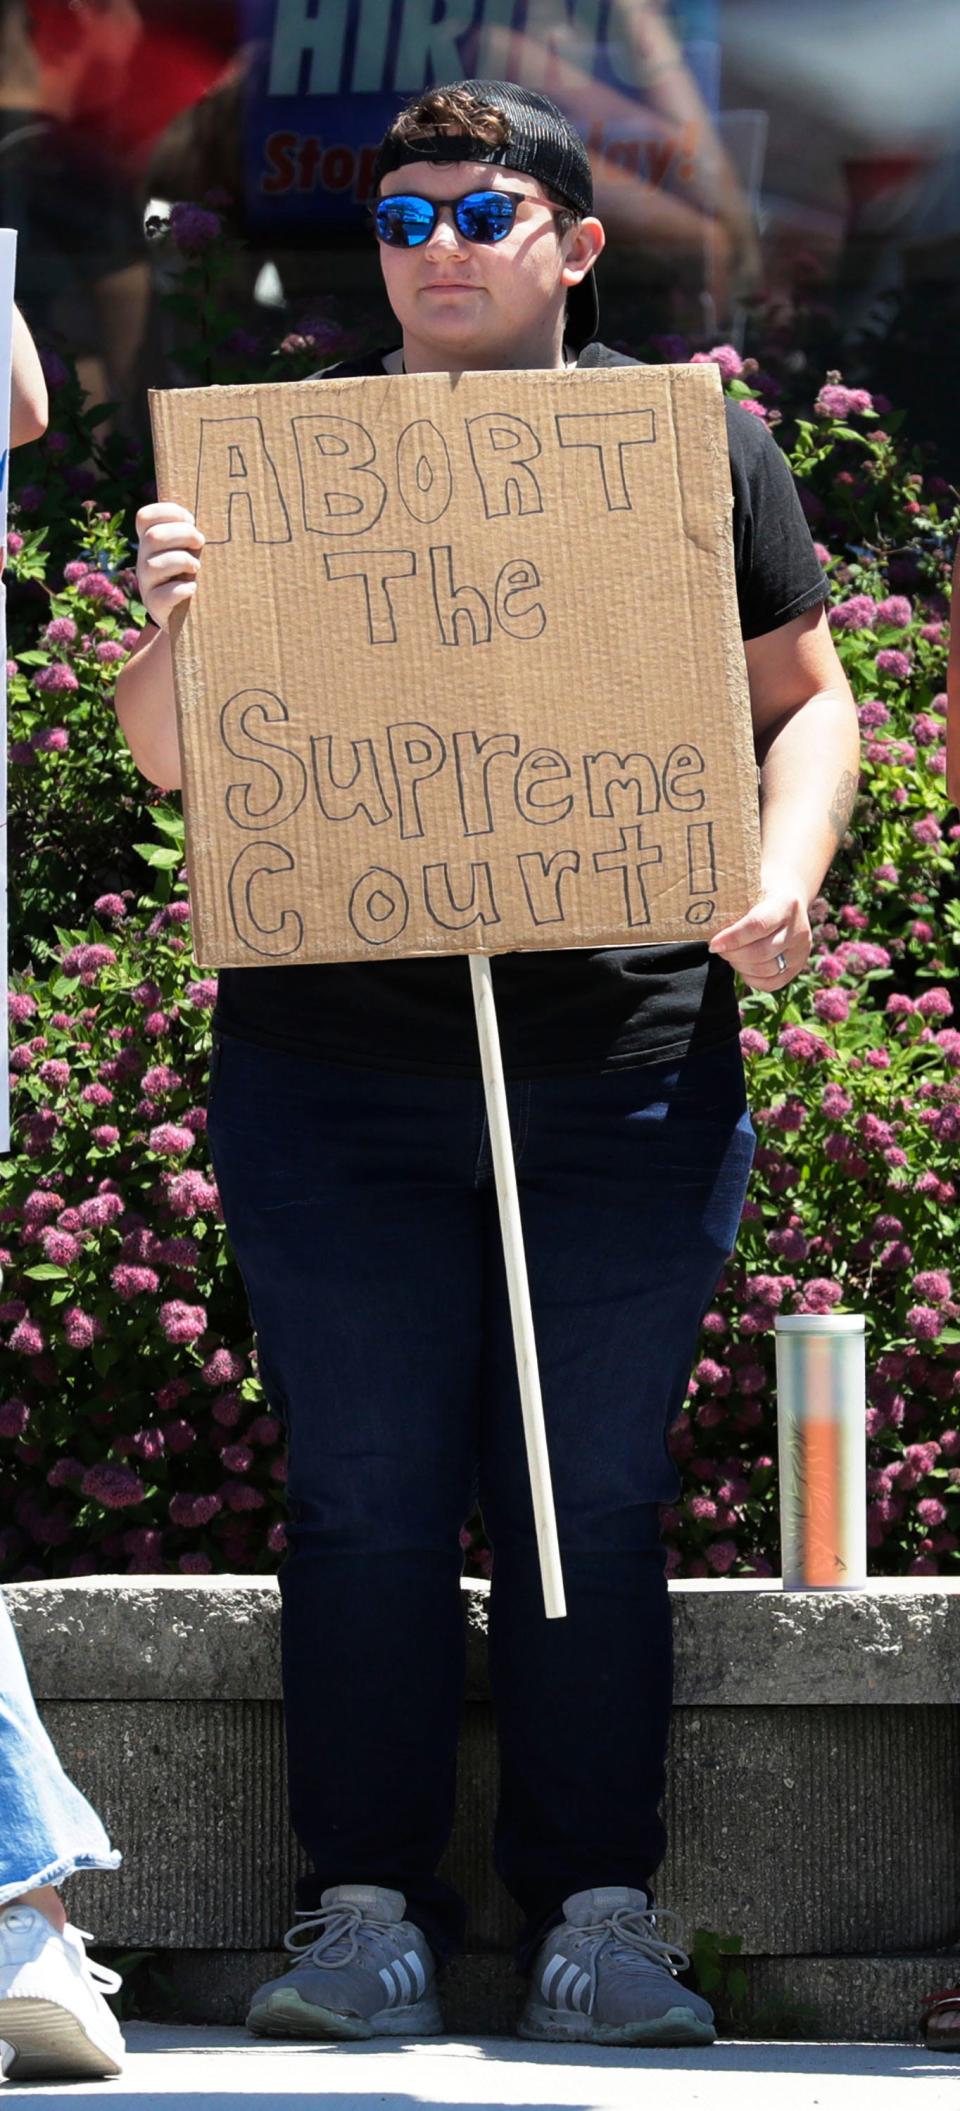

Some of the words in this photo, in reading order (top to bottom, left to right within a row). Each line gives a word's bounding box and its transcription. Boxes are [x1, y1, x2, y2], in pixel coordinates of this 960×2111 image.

[194, 409, 656, 544] ABORT
[323, 545, 547, 646] The
[220, 688, 706, 839] Supreme
[228, 822, 718, 956] Court!
